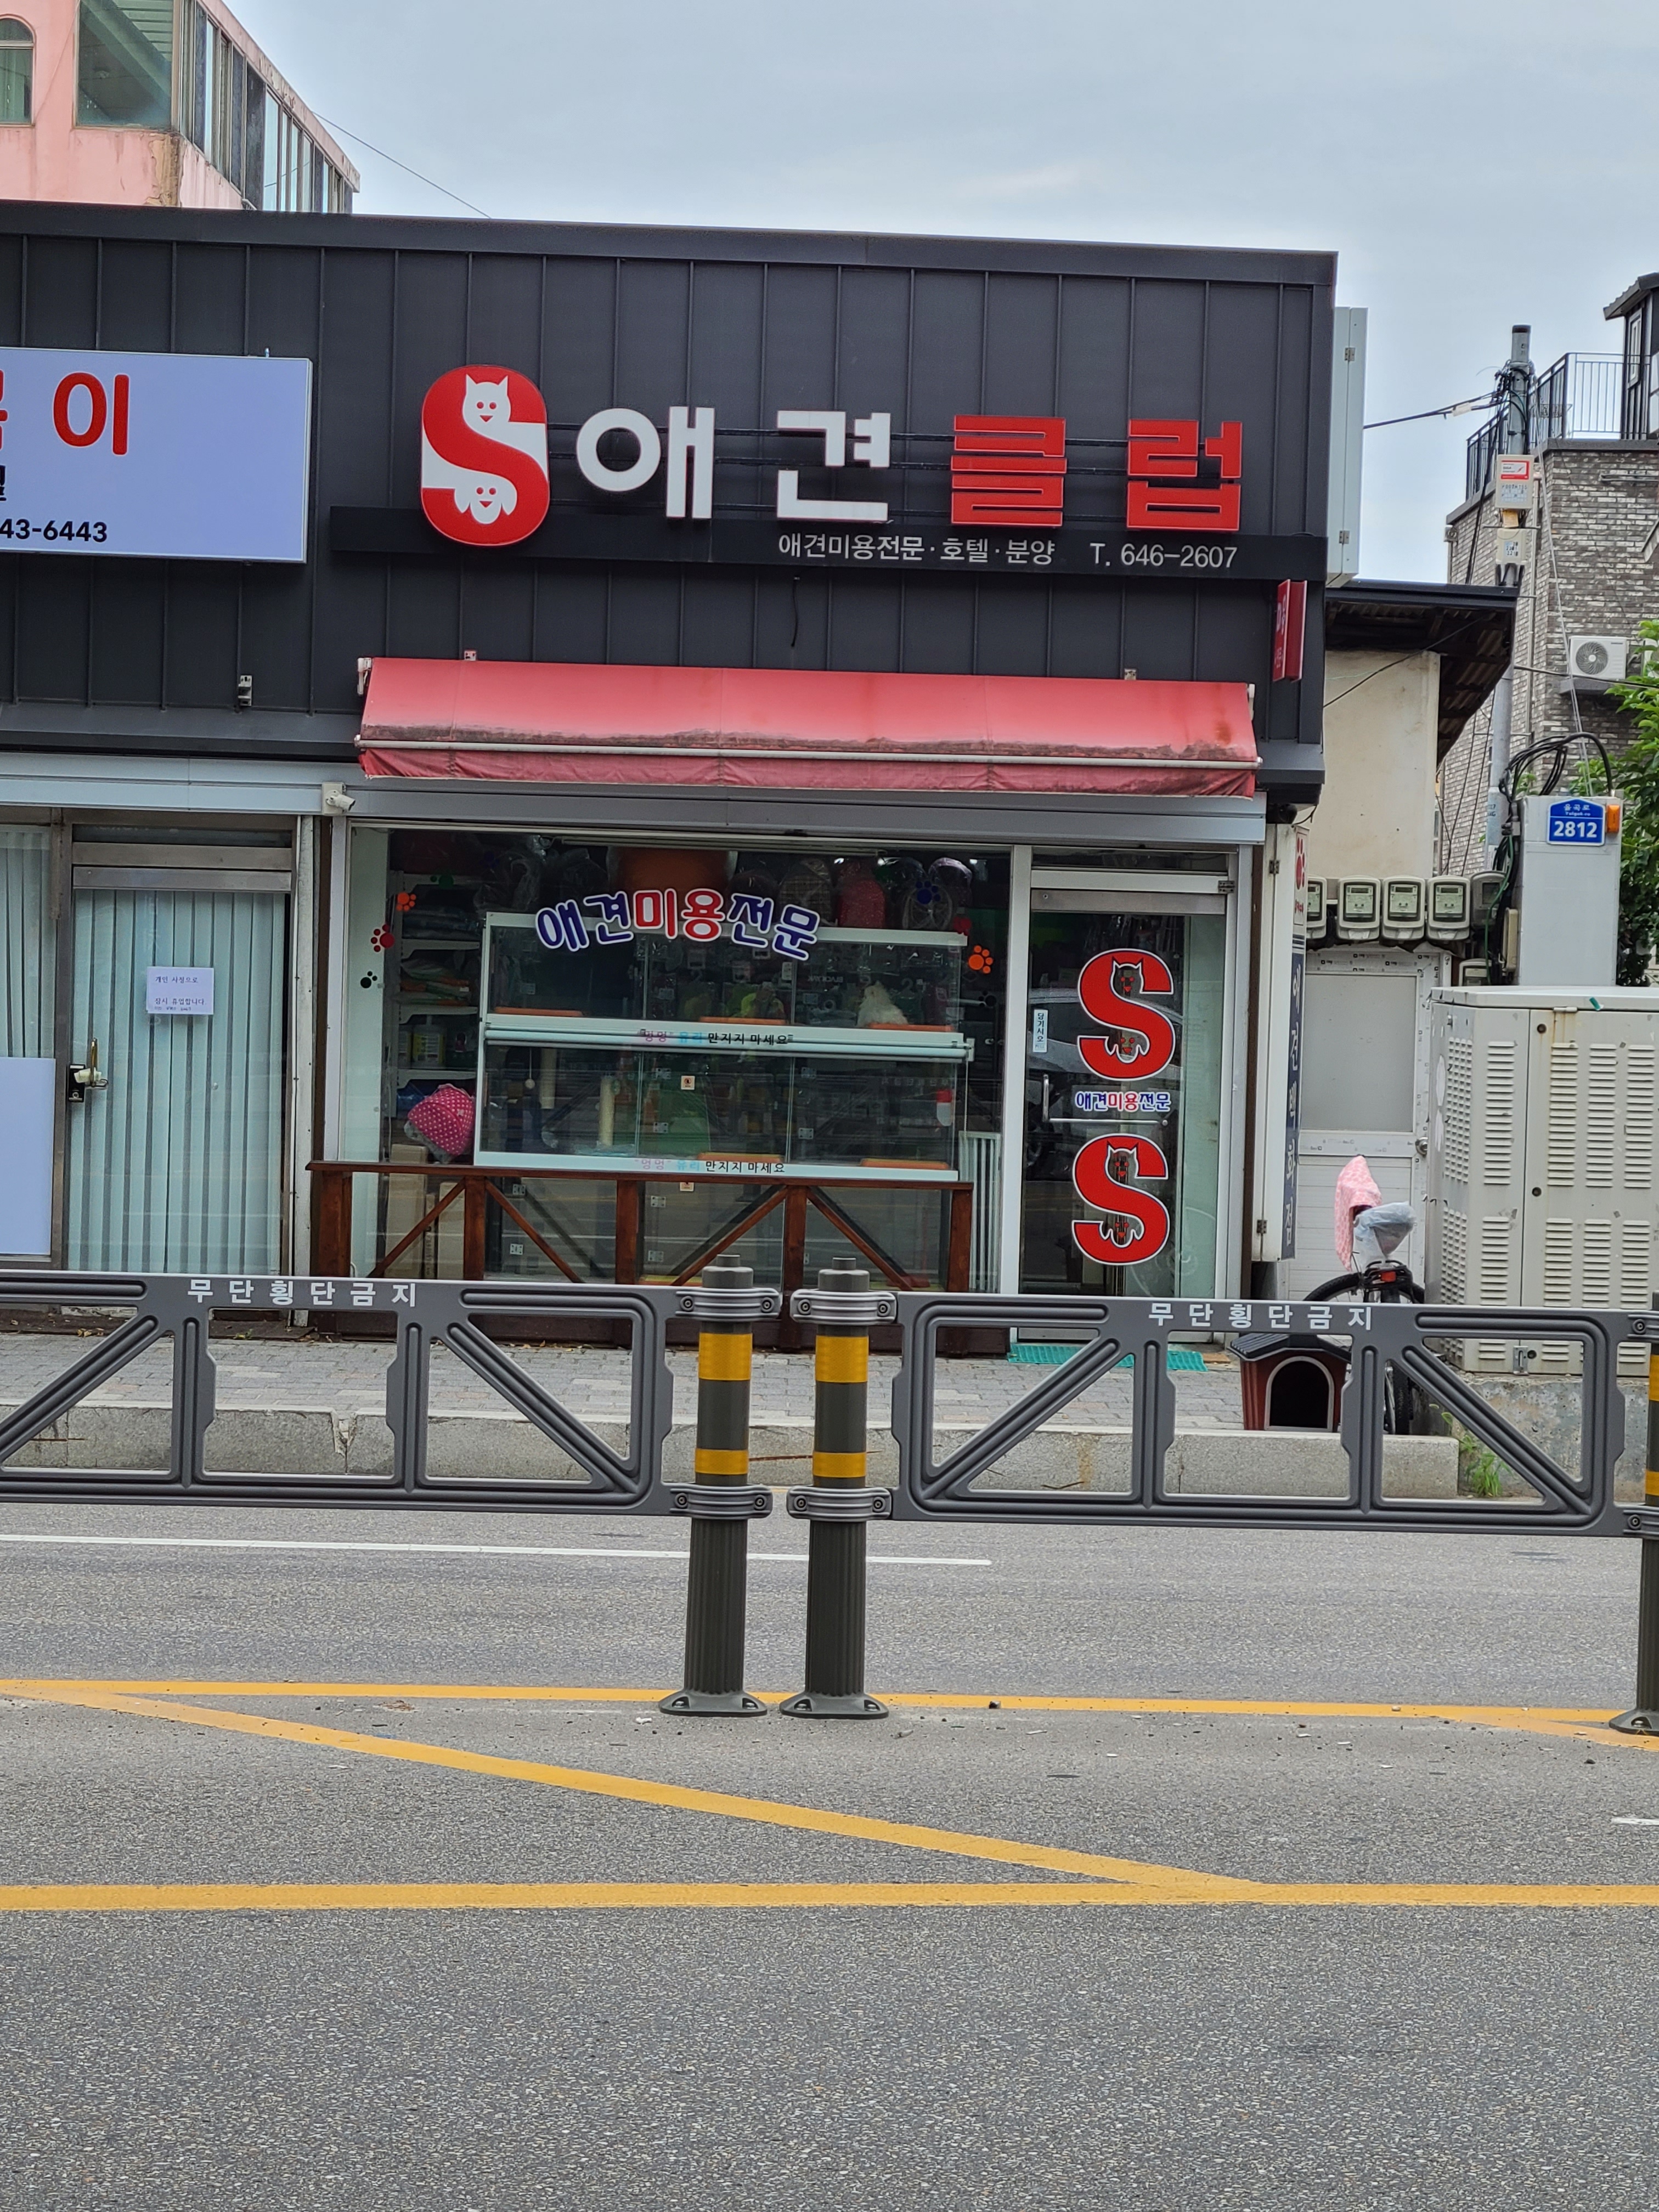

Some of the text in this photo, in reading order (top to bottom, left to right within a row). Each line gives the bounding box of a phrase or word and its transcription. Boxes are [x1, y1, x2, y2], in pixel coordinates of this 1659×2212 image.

[0, 369, 129, 456] 이
[0, 518, 108, 543] 43-6443
[1090, 543, 1238, 568] T. 646-2607
[1554, 821, 1597, 838] 2812
[535, 888, 820, 961] 애견미용전문
[708, 1032, 744, 1045] 만지지
[750, 1034, 788, 1046] 마세요
[1074, 1091, 1171, 1112] 애견미용전문
[677, 1160, 700, 1171] 유리
[706, 1160, 742, 1172] 만지지
[748, 1161, 785, 1174] 마세요
[187, 1279, 416, 1307] 무단횡단금지
[1149, 1302, 1372, 1330] 무단횡단금지
